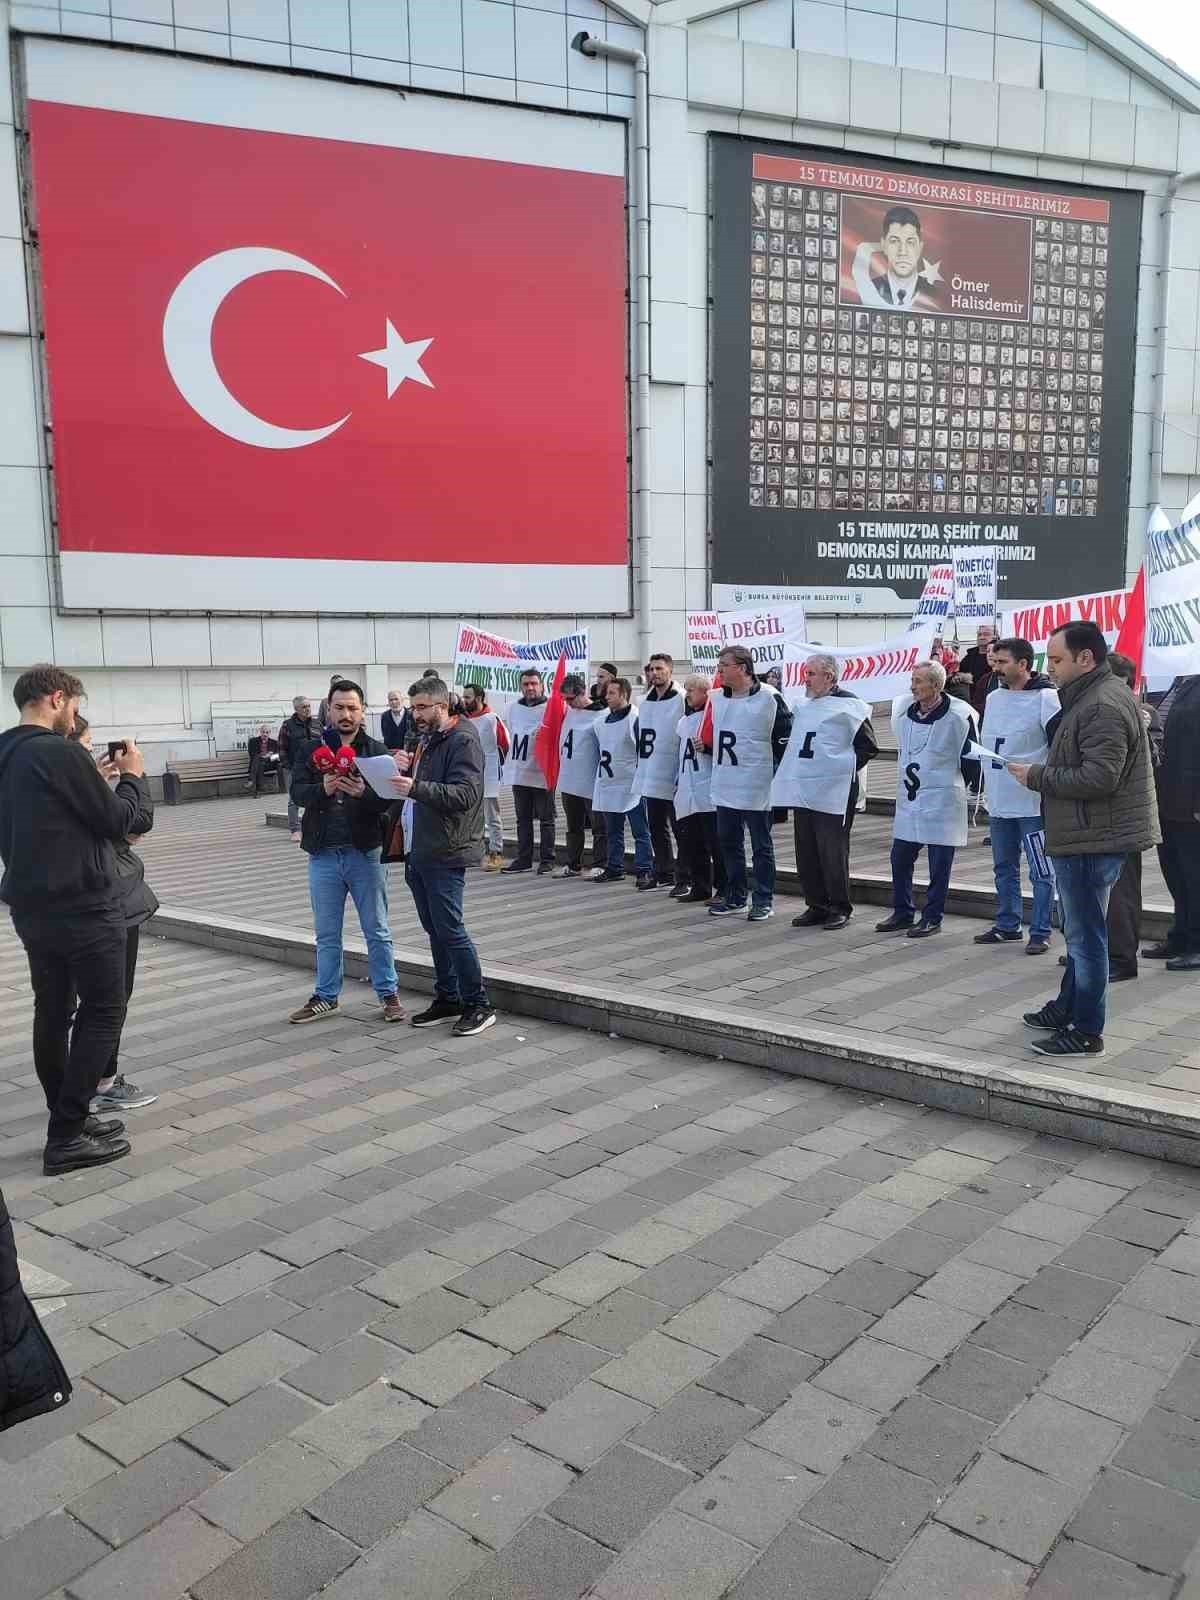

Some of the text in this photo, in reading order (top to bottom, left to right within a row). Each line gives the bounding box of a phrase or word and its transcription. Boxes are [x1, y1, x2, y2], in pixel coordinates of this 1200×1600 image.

[800, 166, 815, 181] 15
[818, 169, 886, 189] TEMMUZ
[888, 178, 973, 202] DEMOKRASİ
[951, 273, 991, 293] Ömer
[951, 294, 1025, 313] Halisdemir
[838, 522, 855, 538] 15
[943, 521, 982, 543] ŞEHİT
[984, 525, 1019, 541] OLAN
[816, 540, 900, 559] DEMOKRASİ
[846, 564, 883, 580] ASLA
[687, 615, 718, 627] YIKIM
[732, 613, 785, 640] DEĞİL
[512, 733, 529, 761] M
[561, 729, 574, 761] A
[639, 728, 656, 759] B
[682, 737, 700, 774] A
[717, 730, 738, 766] R
[599, 750, 614, 778] R
[904, 762, 922, 802] Ş
